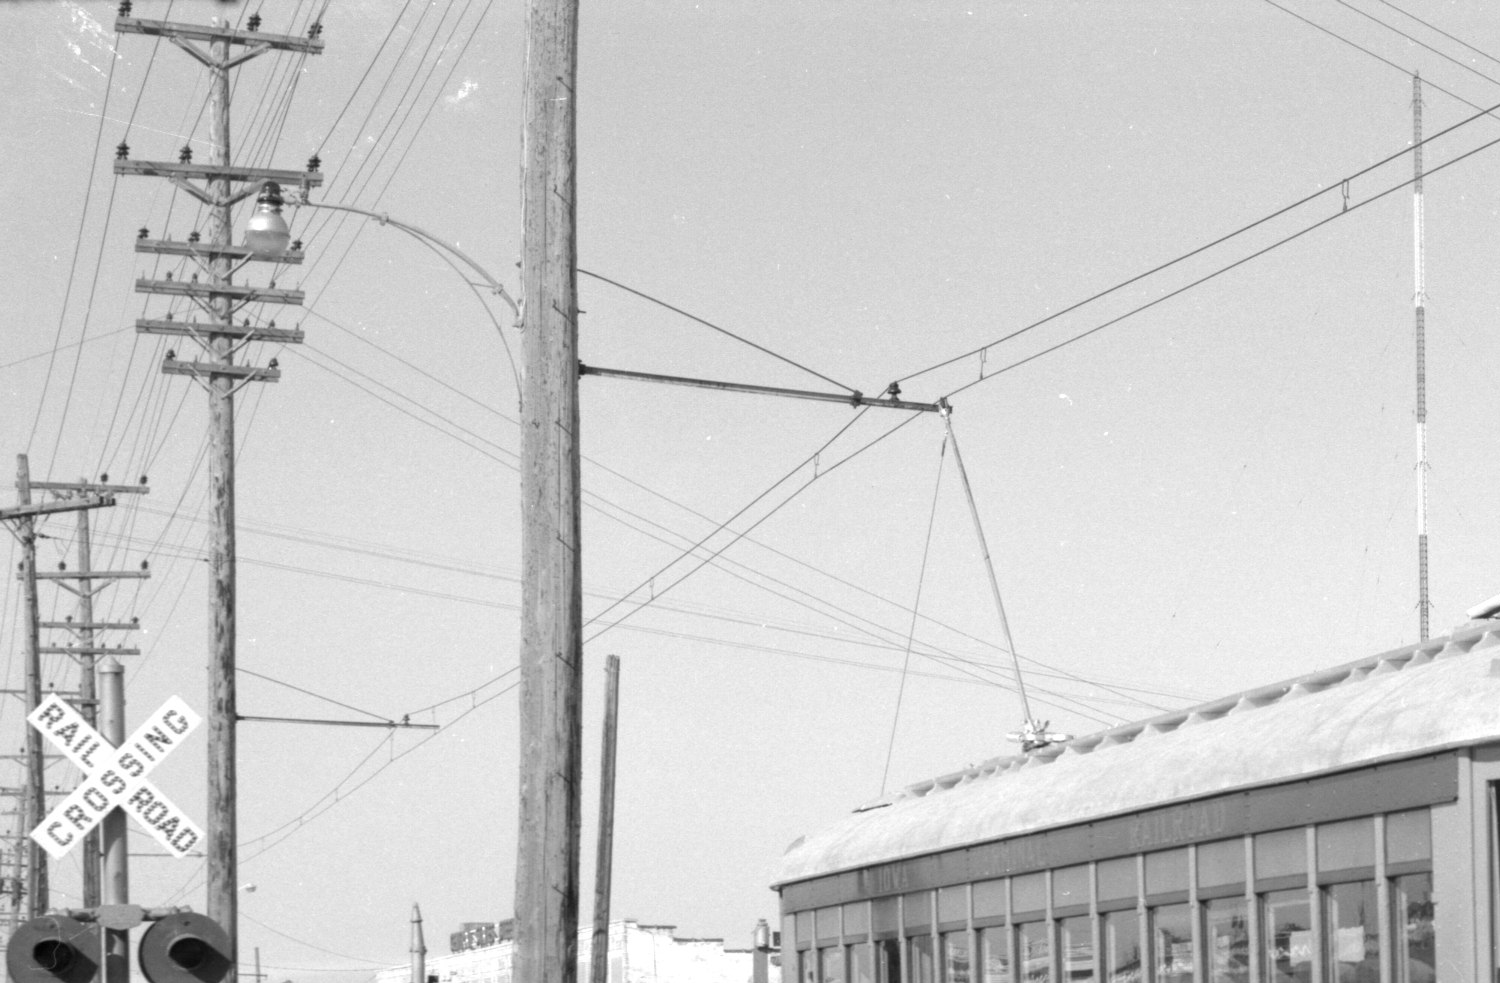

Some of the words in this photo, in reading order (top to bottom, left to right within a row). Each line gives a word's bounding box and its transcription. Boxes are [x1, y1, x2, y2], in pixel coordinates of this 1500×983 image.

[37, 702, 102, 768] RAIL
[128, 786, 199, 853] ROAD
[46, 709, 189, 847] CROSSING
